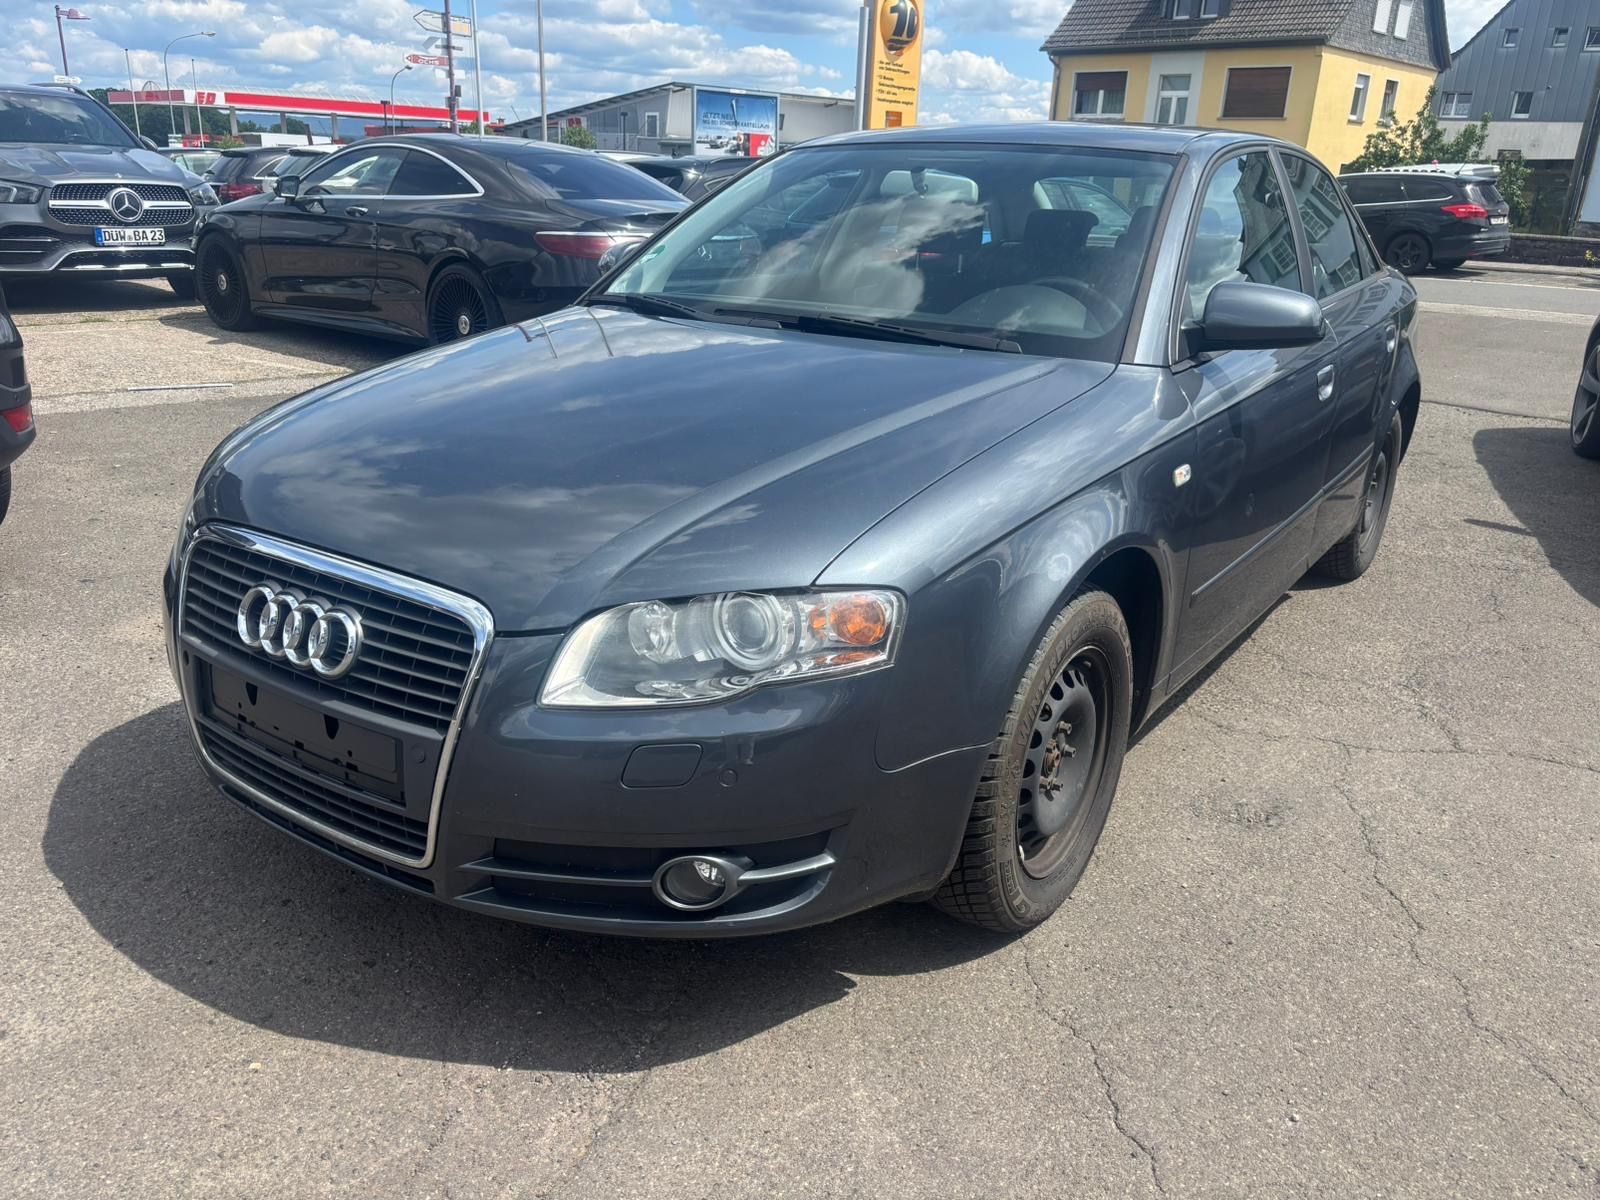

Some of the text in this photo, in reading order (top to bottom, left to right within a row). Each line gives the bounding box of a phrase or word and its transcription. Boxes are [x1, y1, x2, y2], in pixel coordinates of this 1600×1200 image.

[103, 229, 164, 241] DÜW BA 23
